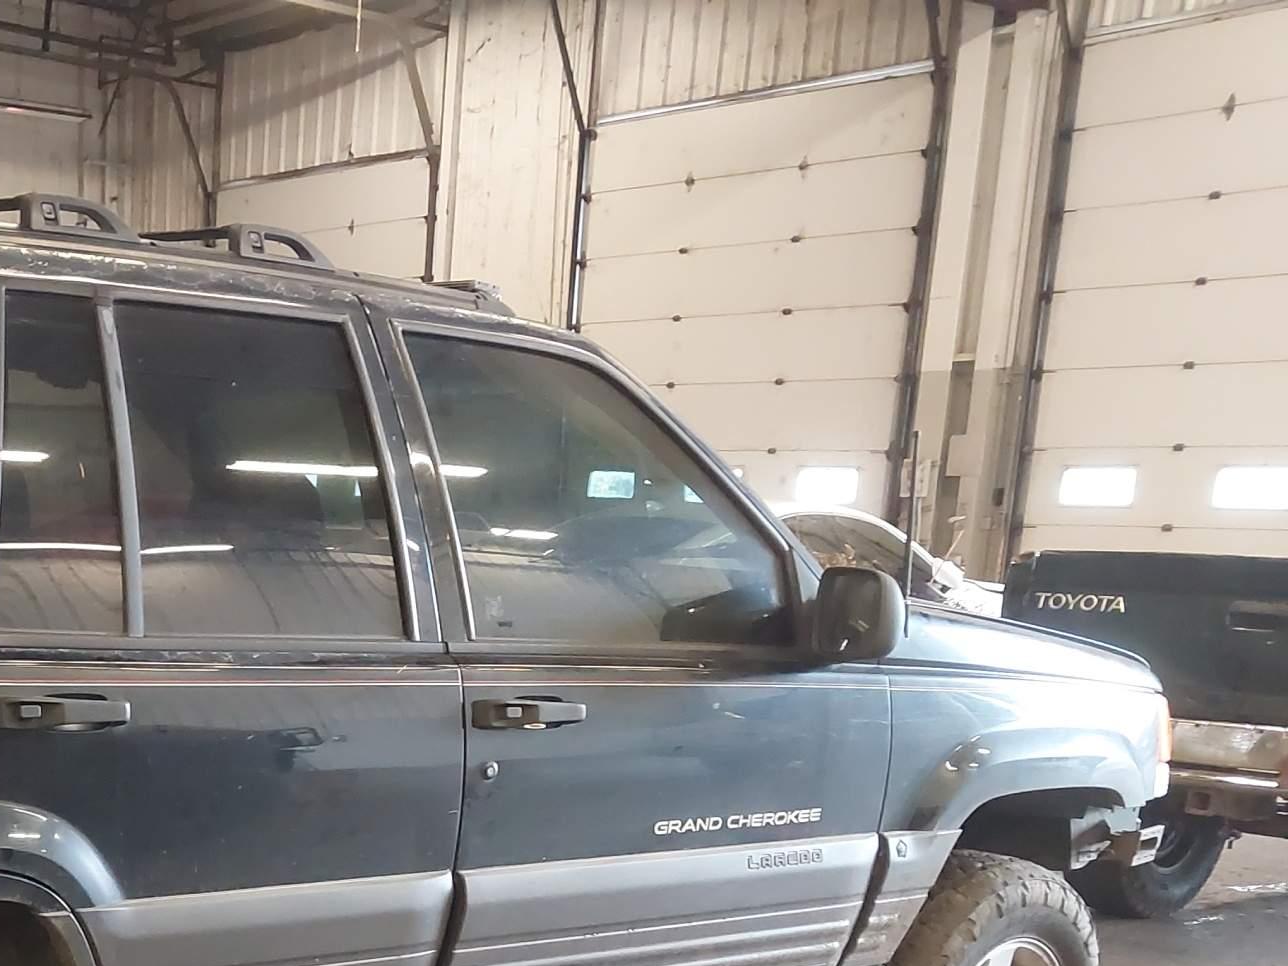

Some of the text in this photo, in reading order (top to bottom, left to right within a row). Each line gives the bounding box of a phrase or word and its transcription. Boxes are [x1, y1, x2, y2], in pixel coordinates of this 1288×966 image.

[1035, 592, 1126, 614] TOYOTA
[653, 807, 823, 835] GRAND CHEROKEE
[747, 848, 823, 870] LAREDO
